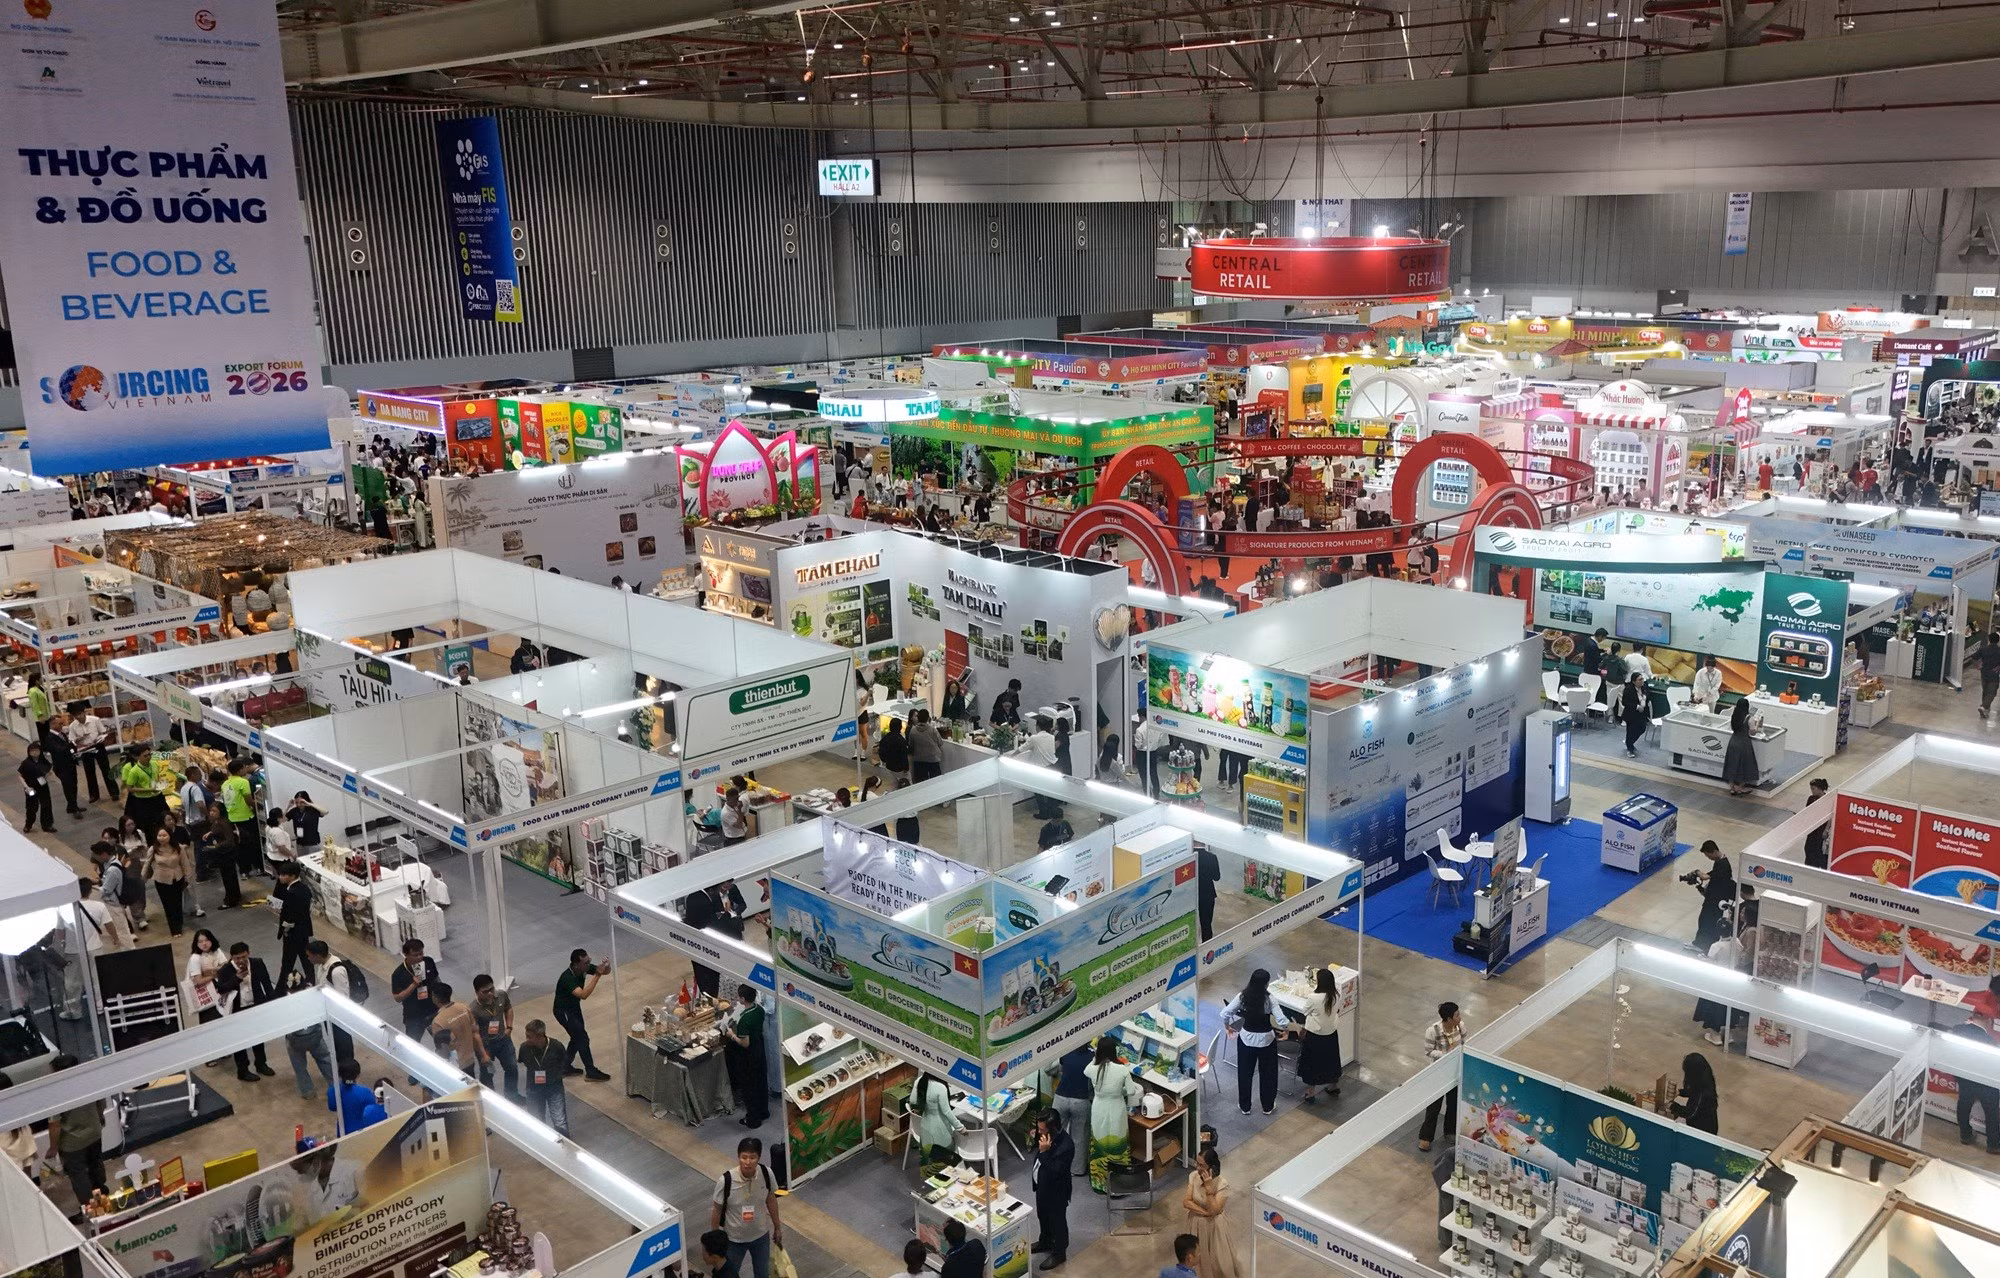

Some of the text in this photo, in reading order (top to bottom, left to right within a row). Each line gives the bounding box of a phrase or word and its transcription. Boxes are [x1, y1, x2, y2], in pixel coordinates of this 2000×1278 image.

[19, 143, 267, 186] THỰC PHẨM
[829, 165, 861, 181] EXIT
[36, 187, 267, 224] & ĐỒ UỐNG
[453, 187, 497, 206] Nhà máy FIS
[88, 250, 237, 278] FOOD &
[1212, 255, 1282, 272] CENTRAL
[1220, 273, 1271, 289] RETAIL
[1408, 271, 1443, 287] RETAIL
[61, 289, 270, 321] BEVERAGE
[1918, 342, 1932, 350] Café
[225, 361, 304, 373] EXPORT FORUM
[1053, 361, 1087, 374] Pavilion
[1168, 362, 1180, 370] CITY
[228, 371, 308, 396] 2026
[109, 393, 212, 410] VIETNAM
[391, 405, 429, 422] NANG CITY
[1052, 435, 1083, 448] DU LỊCH
[1111, 428, 1125, 437] BAN
[1441, 446, 1466, 455] RETAIL
[1135, 458, 1155, 468] RETAIL
[720, 474, 755, 483] PROVINCE
[528, 496, 548, 504] CÔNG
[1104, 516, 1122, 525] RETAIL
[1249, 538, 1373, 549] SIGNATURE PRODUCTS FROM VIETNAM
[1522, 537, 1612, 548] SAO MAI AGRO
[821, 579, 839, 587] SINCE
[137, 615, 186, 629] COMPANY LIMITED
[1766, 613, 1841, 631] SAO MAI AGRO
[1777, 622, 1829, 634] TRUE TO FRUIT
[339, 668, 367, 700] TÀU
[744, 680, 797, 704] thienbut
[731, 722, 741, 731] CTY
[1218, 732, 1263, 749] FOOD BEVERAGE
[1349, 738, 1386, 761] ALO FISH
[757, 742, 798, 759] TNHH DV
[688, 764, 721, 780] SOURCING
[522, 785, 648, 827] FOOD CLUB TRADING COMPANY LIMITED
[1849, 802, 1903, 824] Halo Mee
[476, 823, 516, 842] SOURCING
[1857, 818, 1893, 831] Instant Noodles
[1875, 828, 1897, 839] Flavour
[1932, 820, 1991, 843] Halo Mee
[1605, 839, 1636, 851] ALO FISH
[1935, 842, 1983, 858] Seafood Flavour
[1941, 837, 1979, 850] Instant Noodles
[1748, 865, 1793, 885] SOURCING
[851, 882, 892, 907] READY FOR
[878, 879, 904, 899] IN THE
[1849, 891, 1921, 915] MOSHI VIETNAM
[1252, 895, 1325, 938] NATURE FOODS COMPANY LTD
[1516, 914, 1540, 934] ALO FISH
[669, 930, 721, 959] GREEN COCO FOODS
[1202, 941, 1234, 965] SOURCING
[1091, 928, 1189, 983] RICE GROCERIES FRESH FRUITS
[1178, 964, 1192, 977] N26
[782, 981, 816, 1005] SOURCING
[867, 984, 973, 1035] RICE GROCERIES FRESH FRUITS
[1036, 977, 1168, 1054] GLOBAL AGRICULTURE AND FOOD LTD
[818, 1000, 948, 1067] GLOBAL AGRICULTURE AND FOOD LTD
[992, 1049, 1033, 1079] SOURCING
[961, 1067, 977, 1081] N26
[1586, 1138, 1640, 1166] LOTUS HFC
[1617, 1160, 1639, 1173] THƯƠNG
[313, 1196, 414, 1248] FREEZE DRYING
[315, 1222, 387, 1261] BIMIFOODS
[389, 1195, 445, 1228] FACTORY
[1263, 1211, 1318, 1245] SOURCING
[120, 1223, 178, 1253] BIMIFOODS
[307, 1235, 387, 1278] DISTRIBUTION
[389, 1209, 447, 1242] PARTNERS
[342, 1258, 369, 1275] pricing
[369, 1241, 402, 1261] available
[413, 1229, 426, 1241] this
[428, 1219, 448, 1234] stand
[649, 1238, 671, 1256] P25
[1326, 1241, 1359, 1263] LOTUS
